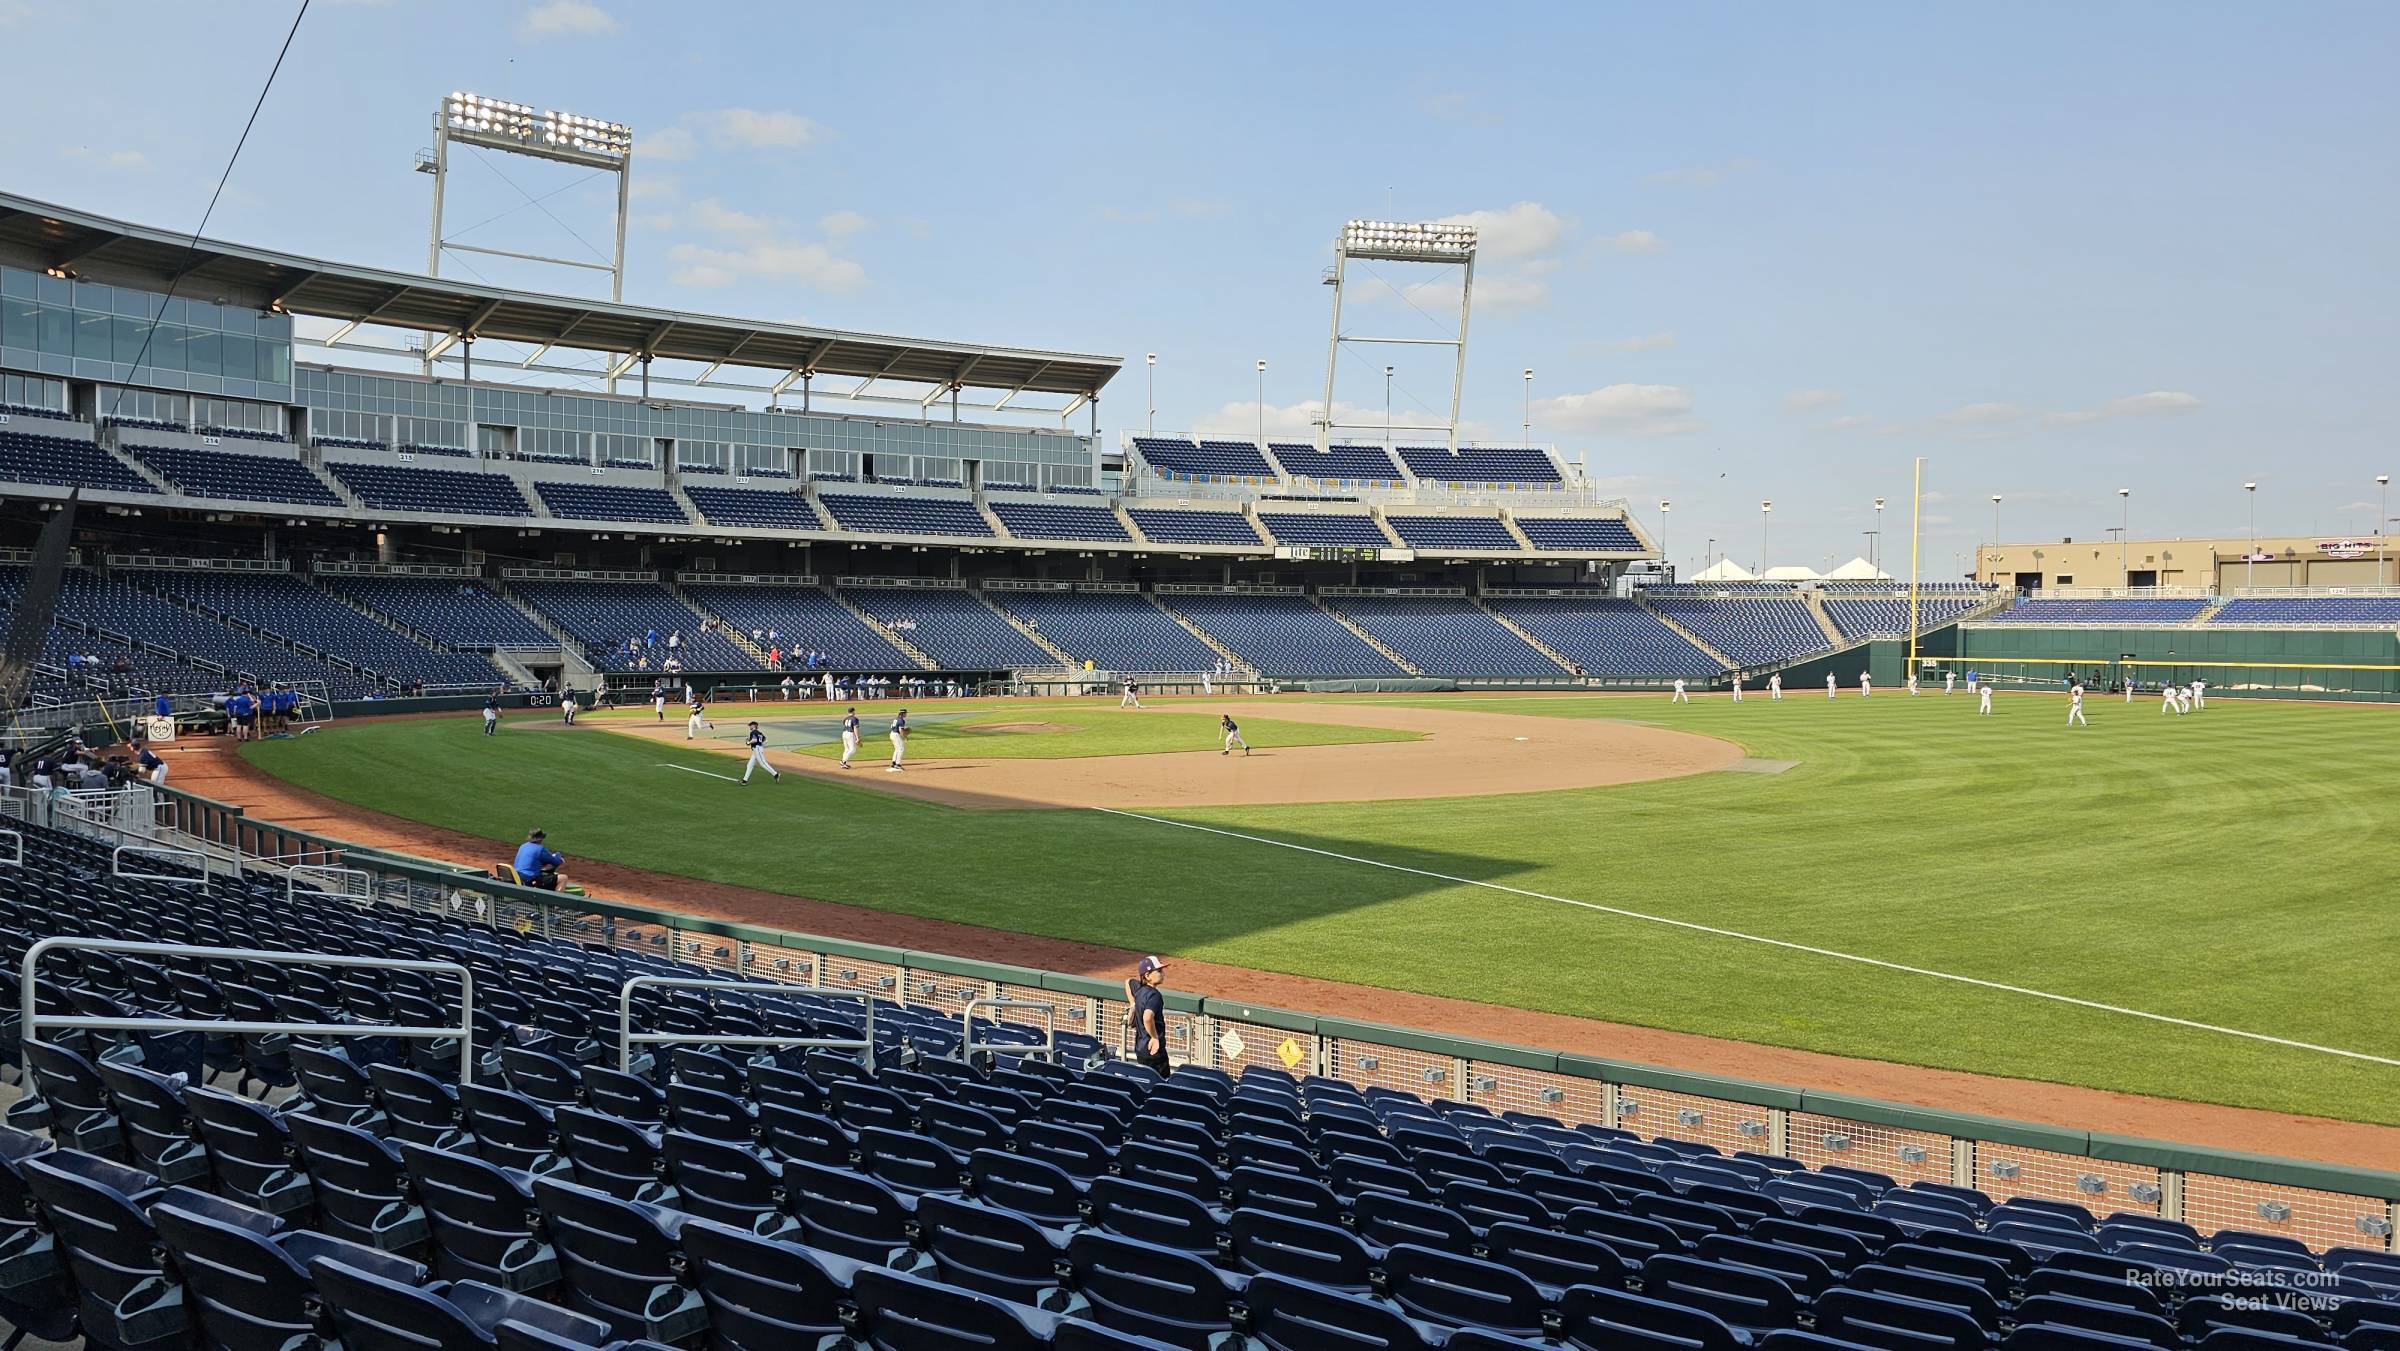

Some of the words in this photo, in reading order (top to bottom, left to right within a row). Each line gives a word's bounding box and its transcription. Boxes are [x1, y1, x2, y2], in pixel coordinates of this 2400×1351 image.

[1922, 659, 1937, 667] 335
[530, 695, 551, 705] 0:20
[38, 760, 44, 769] 11
